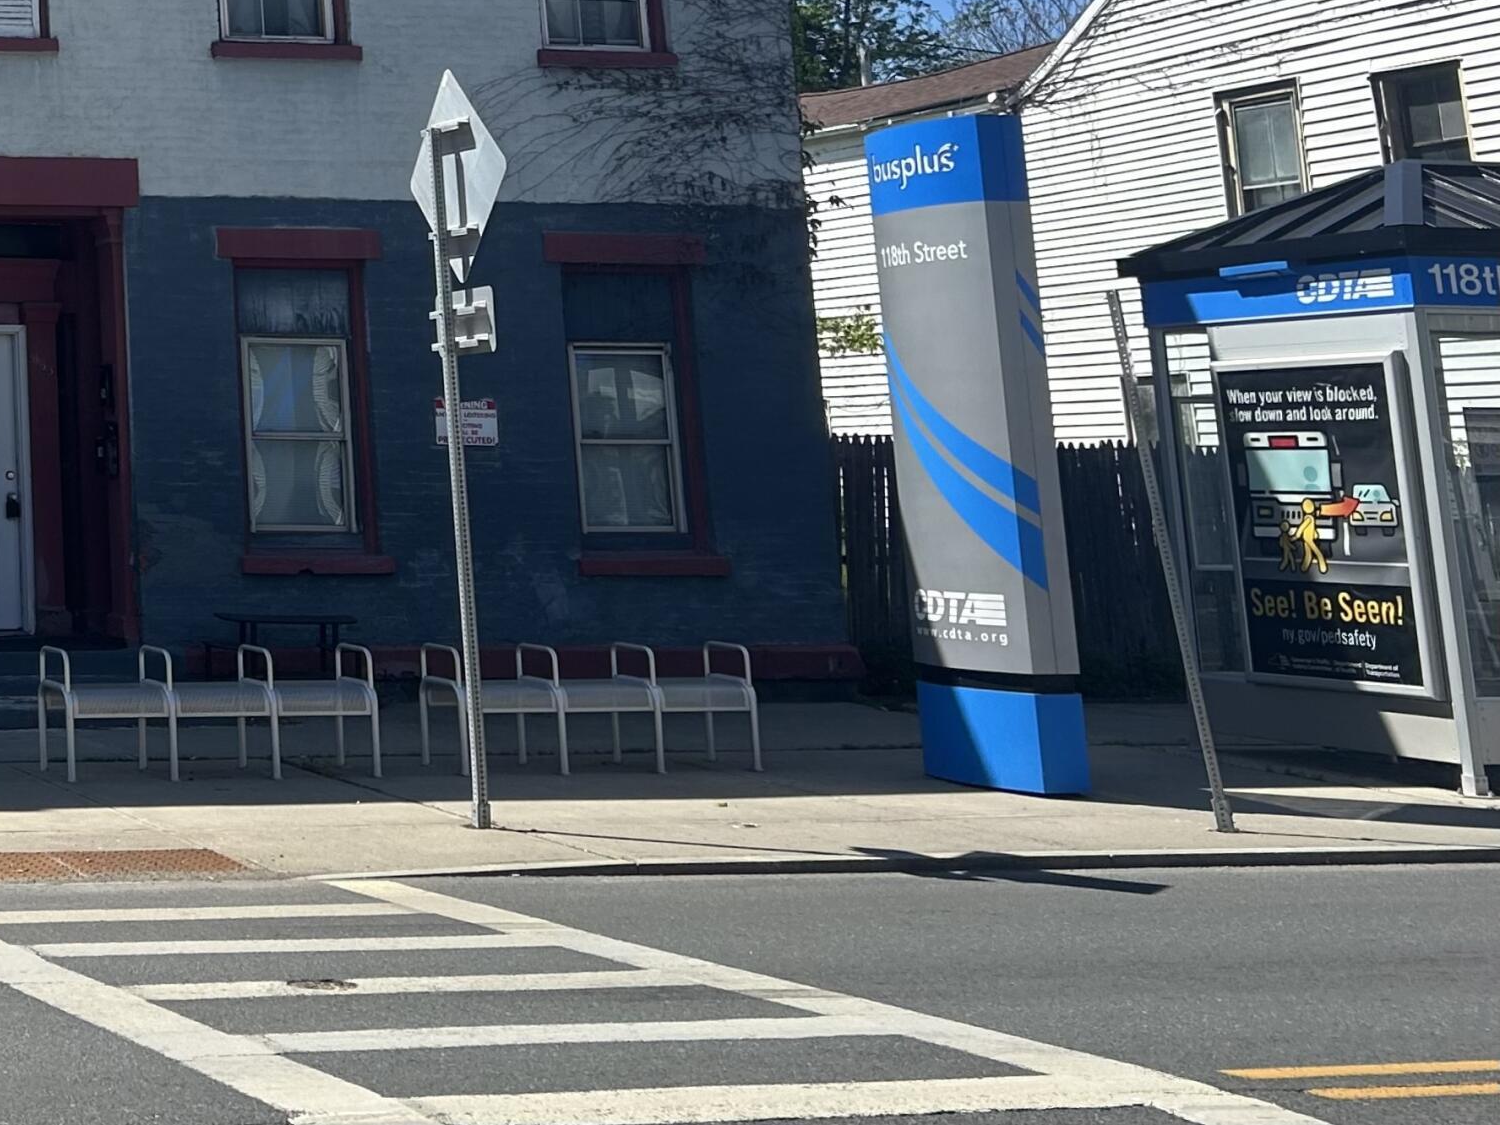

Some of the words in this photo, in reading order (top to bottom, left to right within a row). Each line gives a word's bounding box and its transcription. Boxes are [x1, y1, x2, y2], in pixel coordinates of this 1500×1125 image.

[881, 242, 911, 268] 118th
[913, 240, 968, 264] Street
[1296, 268, 1394, 304] CDTA
[1226, 389, 1256, 404] When
[1258, 391, 1283, 406] your
[1286, 387, 1312, 402] view
[1313, 387, 1324, 402] is
[1326, 385, 1378, 402] blocked,
[1229, 408, 1252, 423] slow
[1255, 407, 1283, 422] down
[1286, 406, 1307, 421] and
[1309, 406, 1333, 421] look
[1335, 404, 1379, 421] around.
[915, 588, 1007, 627] CDTA
[1251, 587, 1297, 618] See!
[1303, 590, 1333, 620] Be
[1337, 591, 1403, 625] Seen!
[1282, 628, 1377, 650] ny.gov/pedsafety
